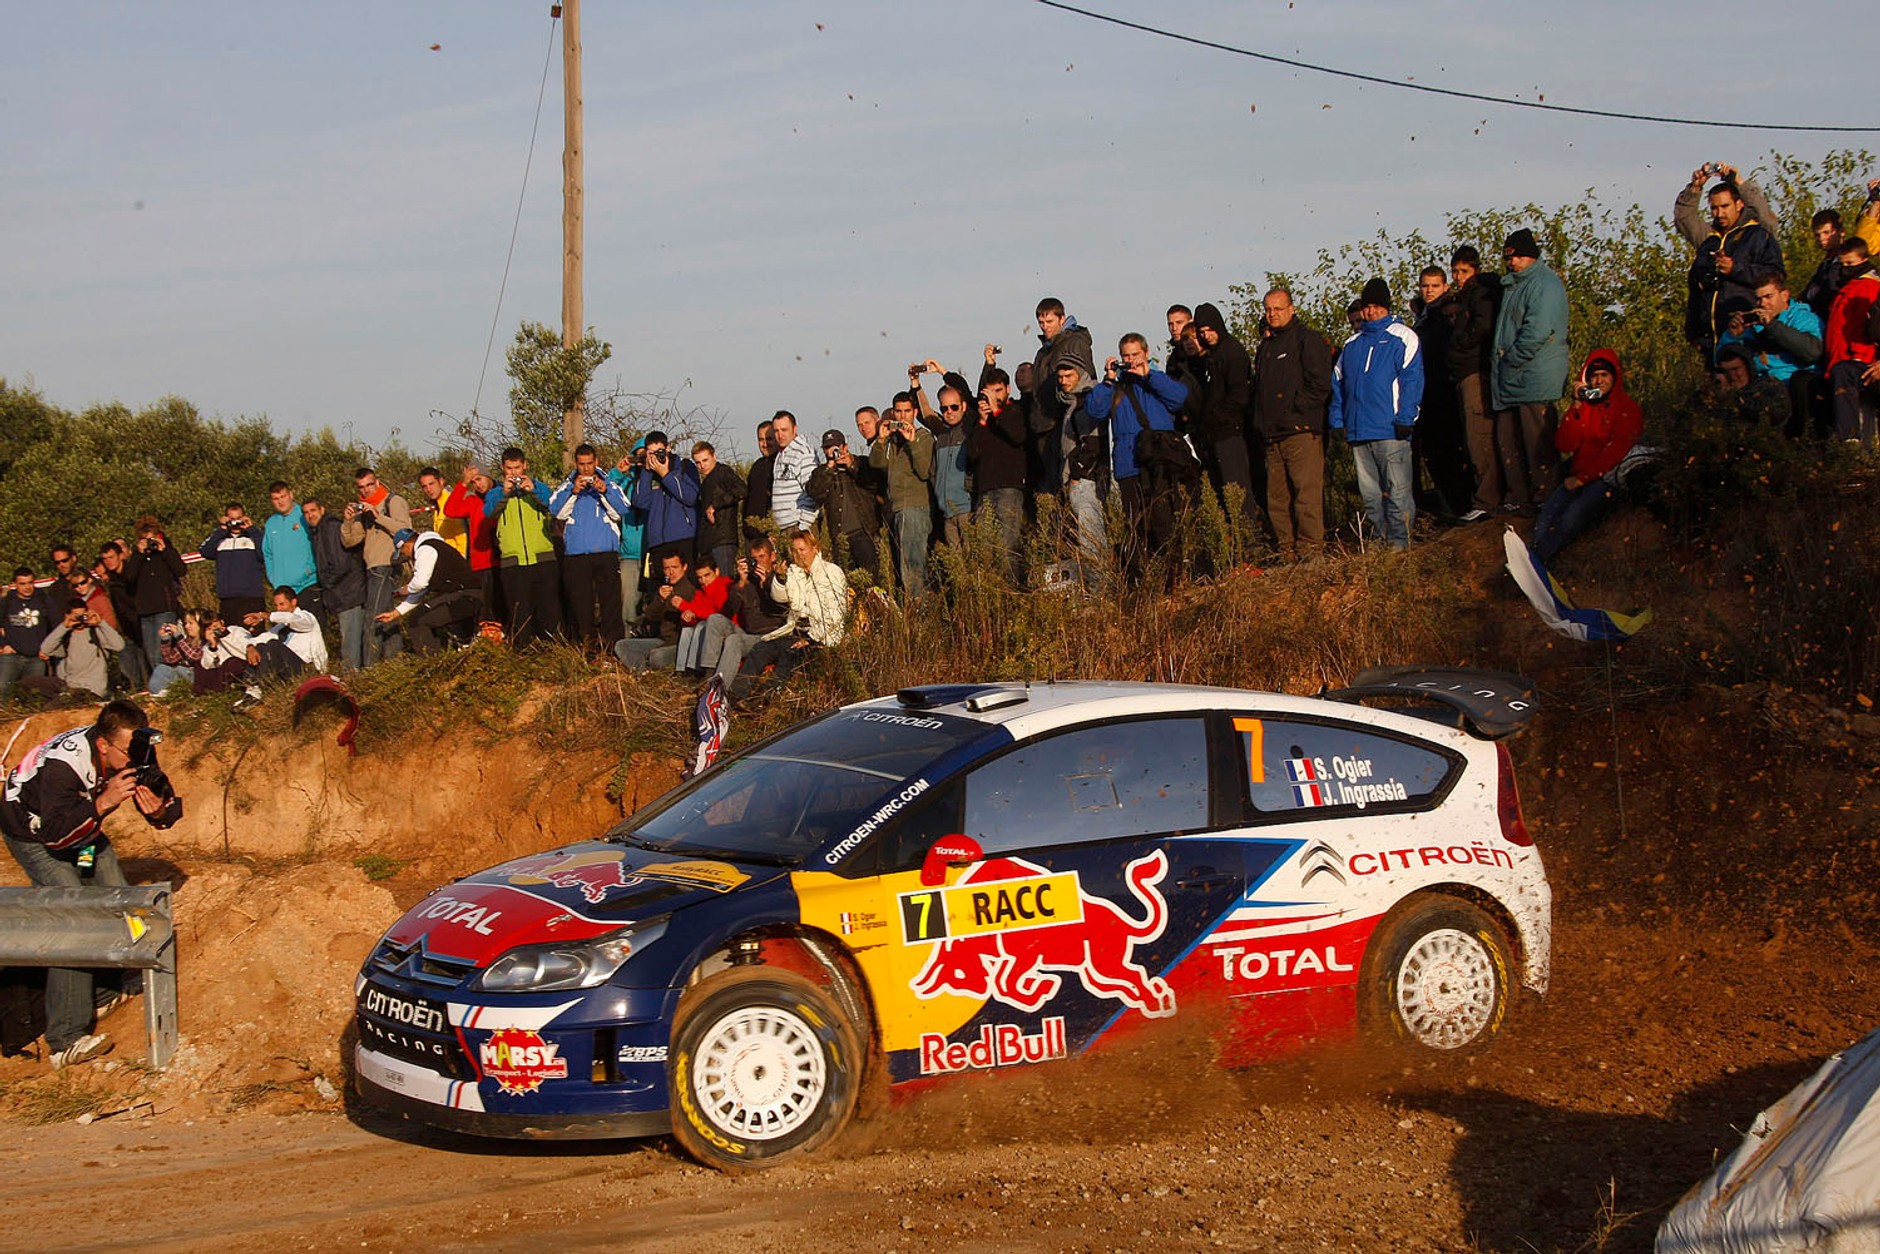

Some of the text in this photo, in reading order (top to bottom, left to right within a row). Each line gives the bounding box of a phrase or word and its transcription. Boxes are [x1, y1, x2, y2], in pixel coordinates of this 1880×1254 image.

[1232, 717, 1265, 783] 7
[1313, 756, 1373, 784] S. Ogier
[1323, 778, 1408, 809] J. Ingrassia
[824, 778, 931, 865] CITROEN-WRC.COM
[934, 846, 969, 856] TOTAL
[1348, 840, 1513, 876] CITROËN
[417, 896, 502, 936] TOTAL
[910, 893, 933, 939] 7
[972, 882, 1055, 926] RACC
[1213, 945, 1354, 981] TOTAL
[367, 988, 444, 1032] CITROËN
[364, 1019, 443, 1055] RACING
